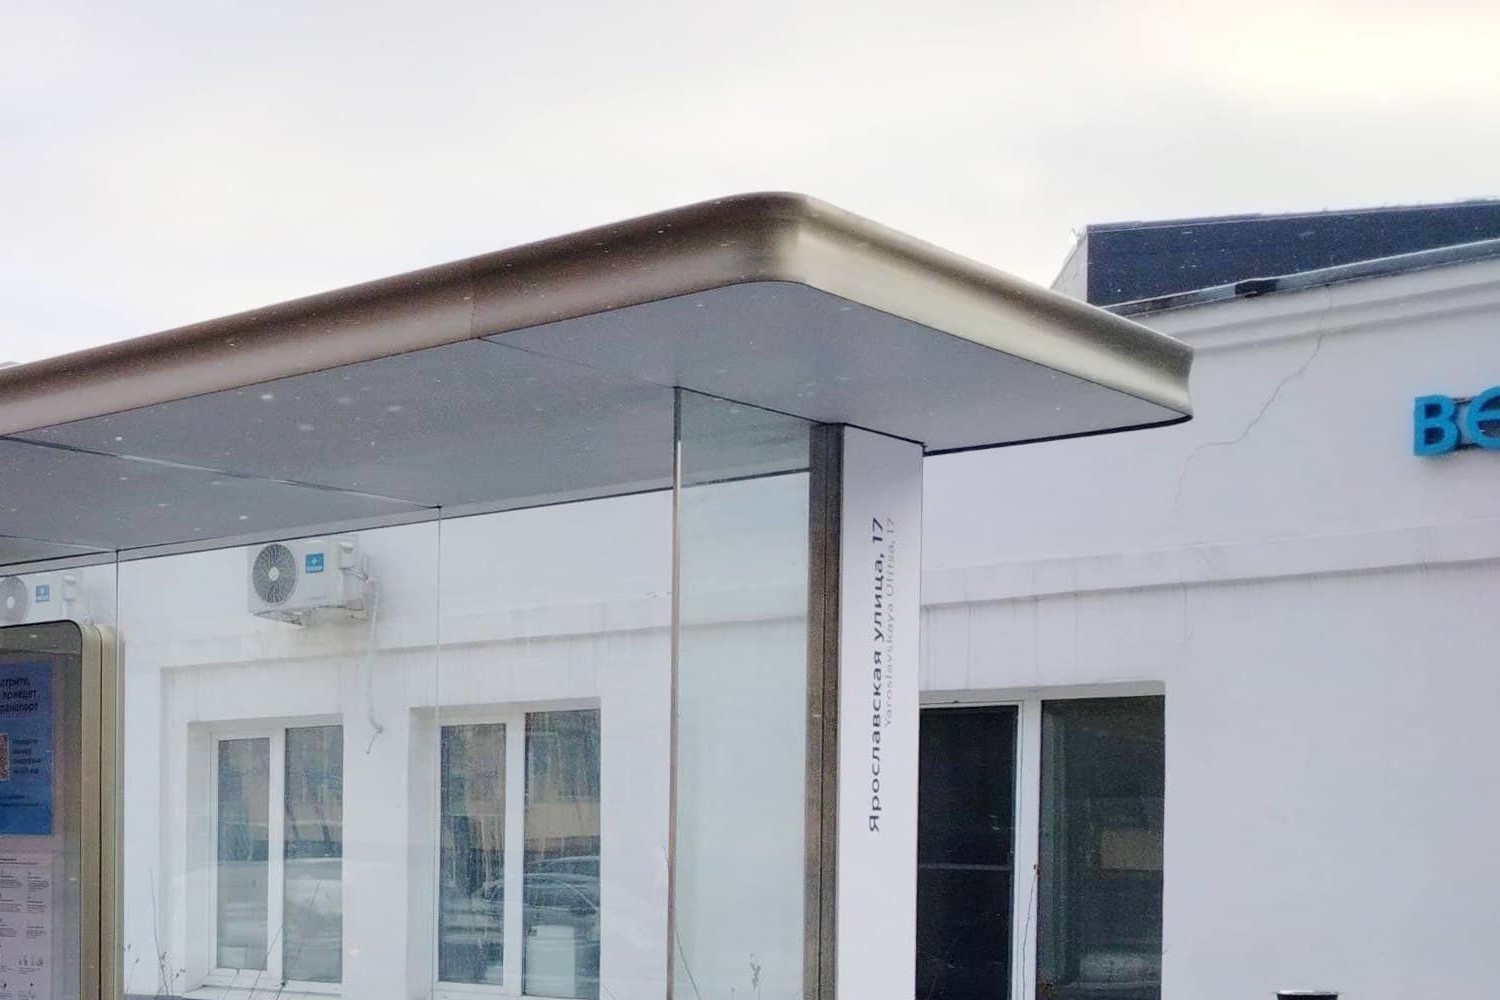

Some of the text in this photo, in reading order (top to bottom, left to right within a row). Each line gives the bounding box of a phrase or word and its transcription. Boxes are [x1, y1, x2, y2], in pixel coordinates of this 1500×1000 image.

[886, 517, 896, 534] 17
[868, 517, 885, 832] Ярославская улица, 17
[884, 602, 894, 729] Yaroslavskaya
